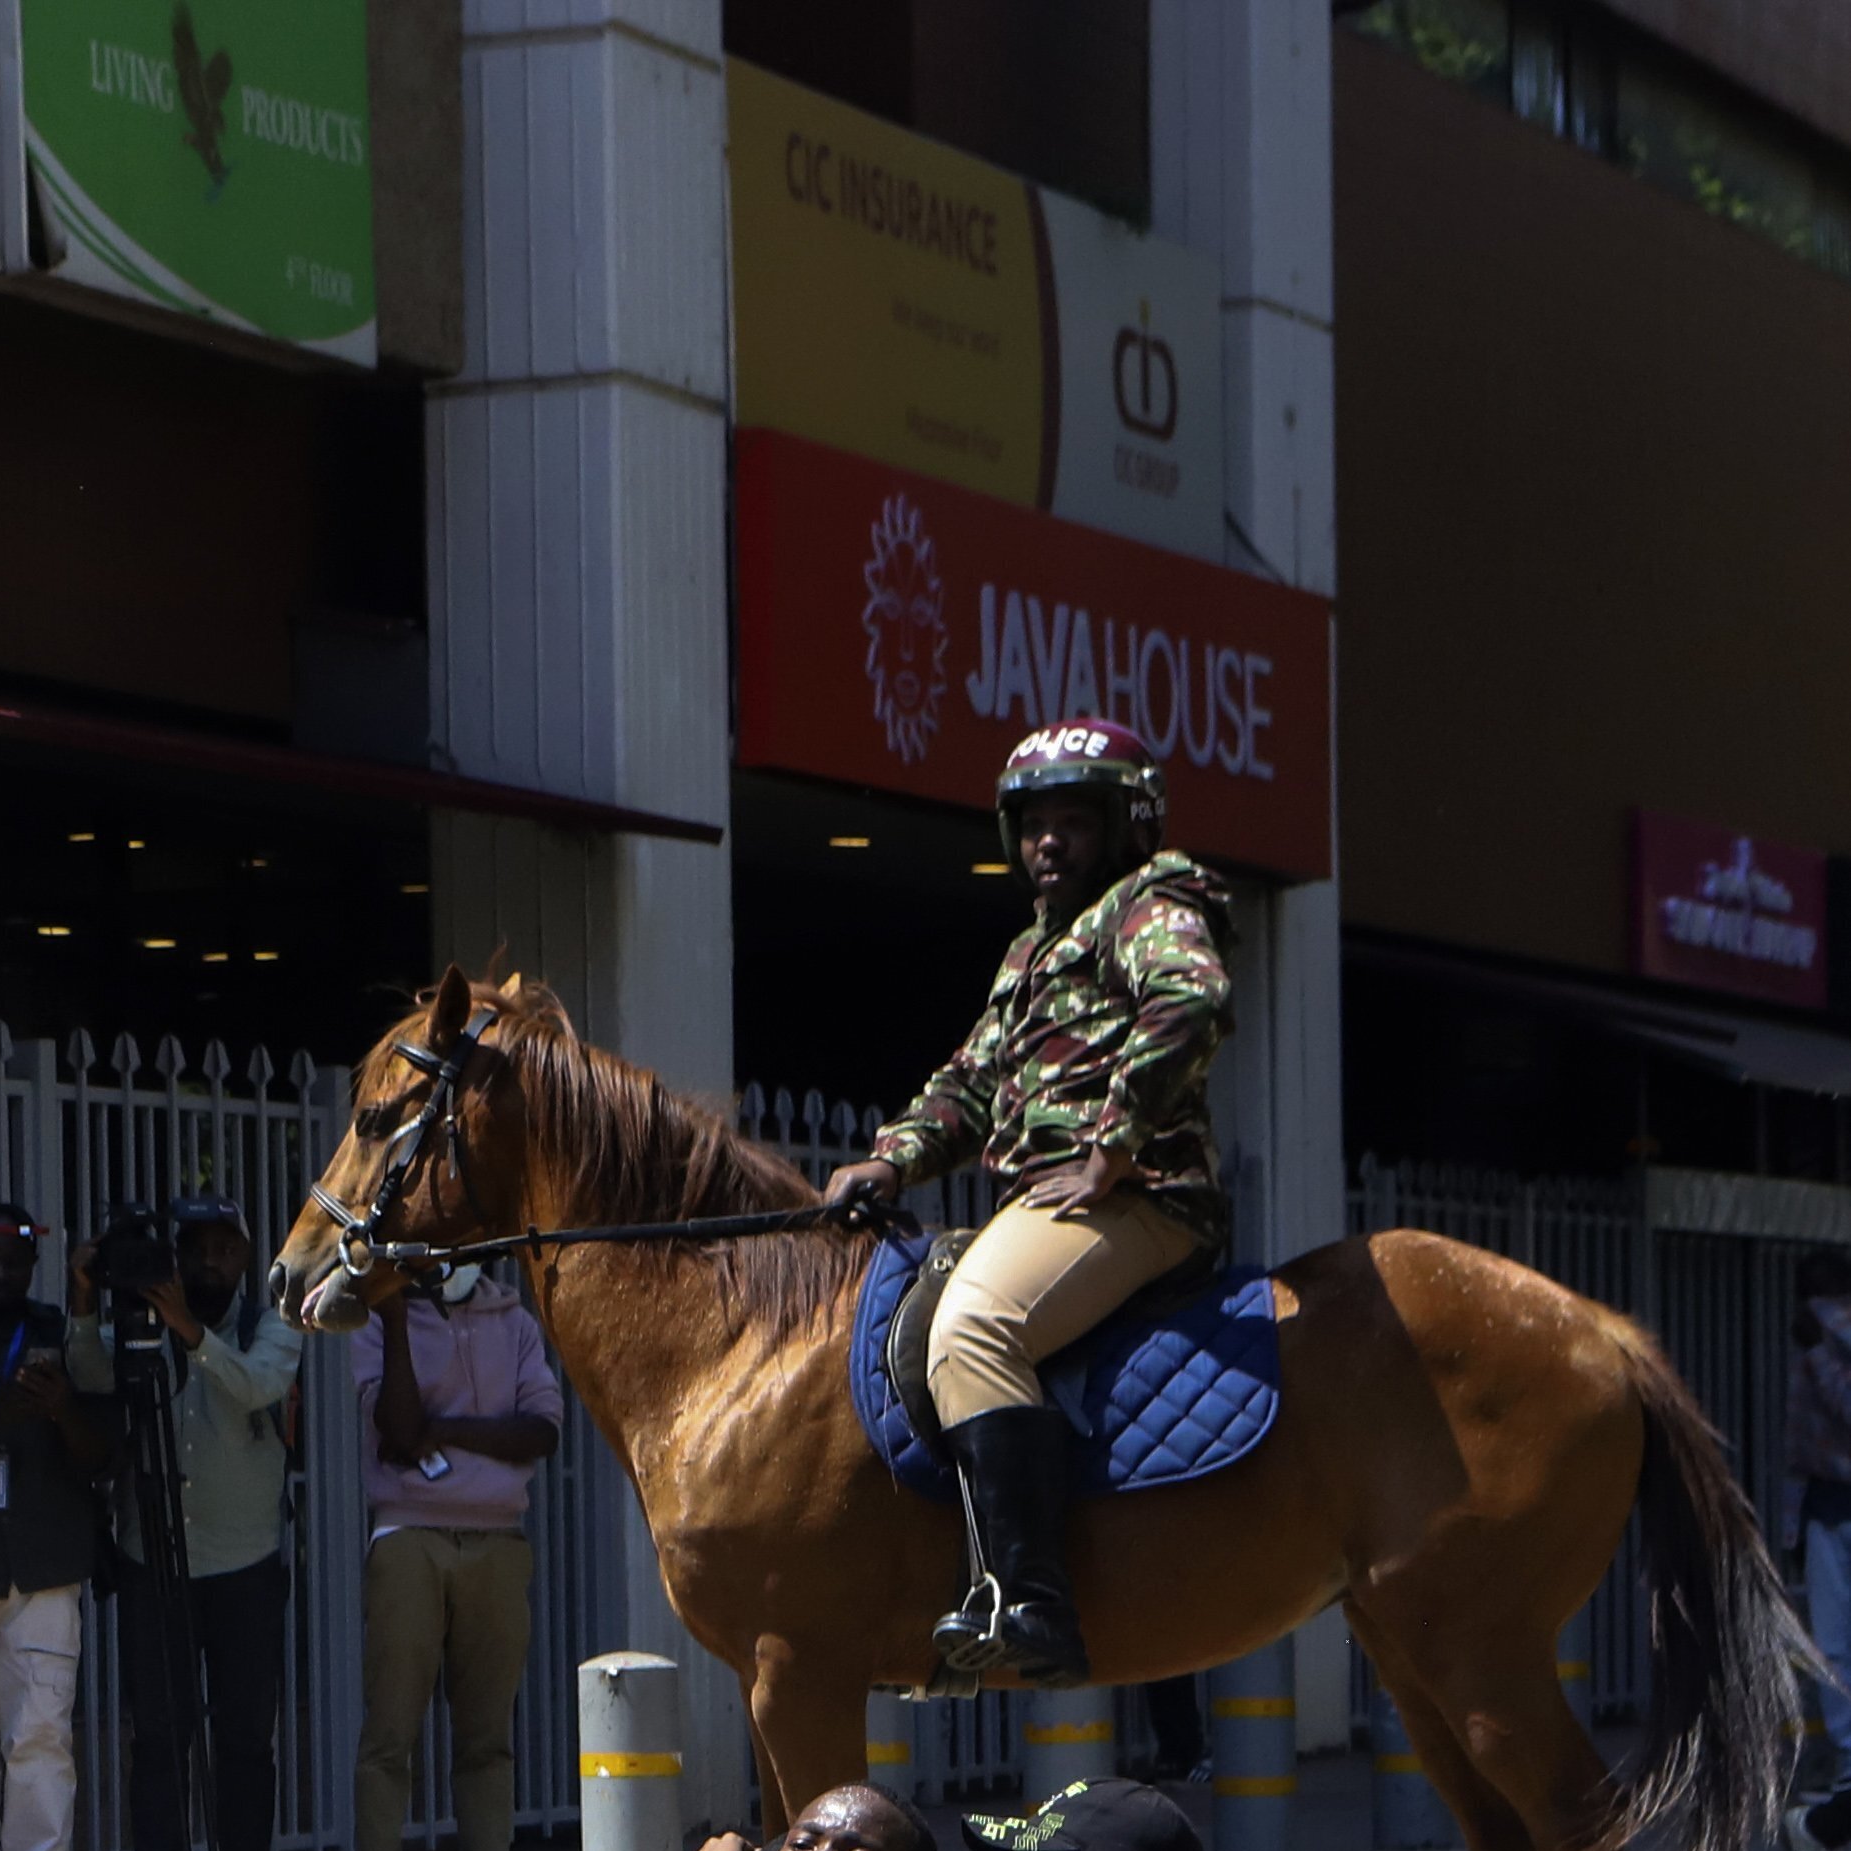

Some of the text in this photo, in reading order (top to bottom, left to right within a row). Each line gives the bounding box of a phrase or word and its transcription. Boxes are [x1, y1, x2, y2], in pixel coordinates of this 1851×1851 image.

[90, 38, 363, 167] LIVING PRODUCTS
[784, 131, 997, 277] CIC INSURANCE
[966, 582, 1274, 780] JAVA HOUSE
